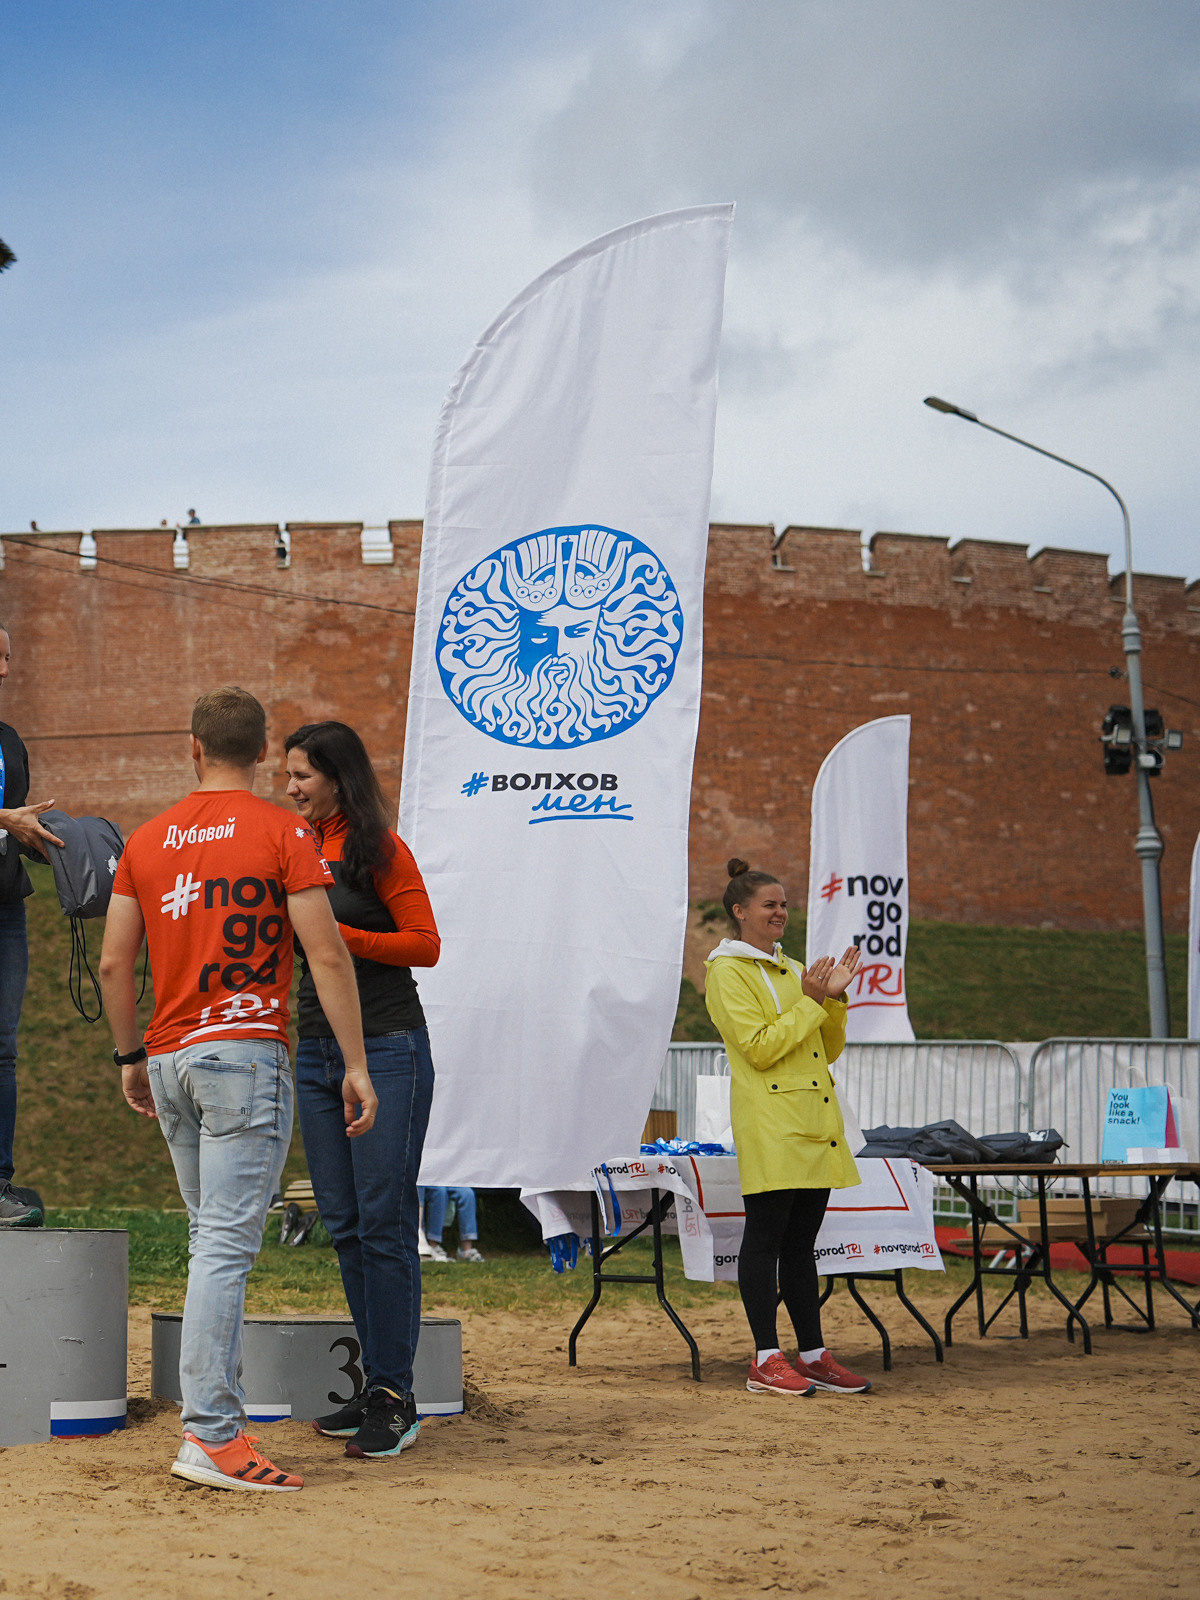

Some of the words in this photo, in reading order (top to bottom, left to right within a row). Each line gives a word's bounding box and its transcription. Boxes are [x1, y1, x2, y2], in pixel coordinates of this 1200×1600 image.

[163, 817, 236, 850] Дубовой
[160, 871, 286, 921] #nov
[821, 872, 904, 904] #nov
[867, 899, 902, 931] go
[222, 913, 283, 959] go
[853, 924, 901, 957] rod
[856, 963, 903, 996] TRI
[1108, 1108, 1126, 1116] like
[1110, 1101, 1130, 1109] look
[1111, 1093, 1129, 1101] You
[1107, 1117, 1140, 1125] snack!
[874, 1242, 935, 1254] #novgorodTRI
[327, 1336, 364, 1405] 3
